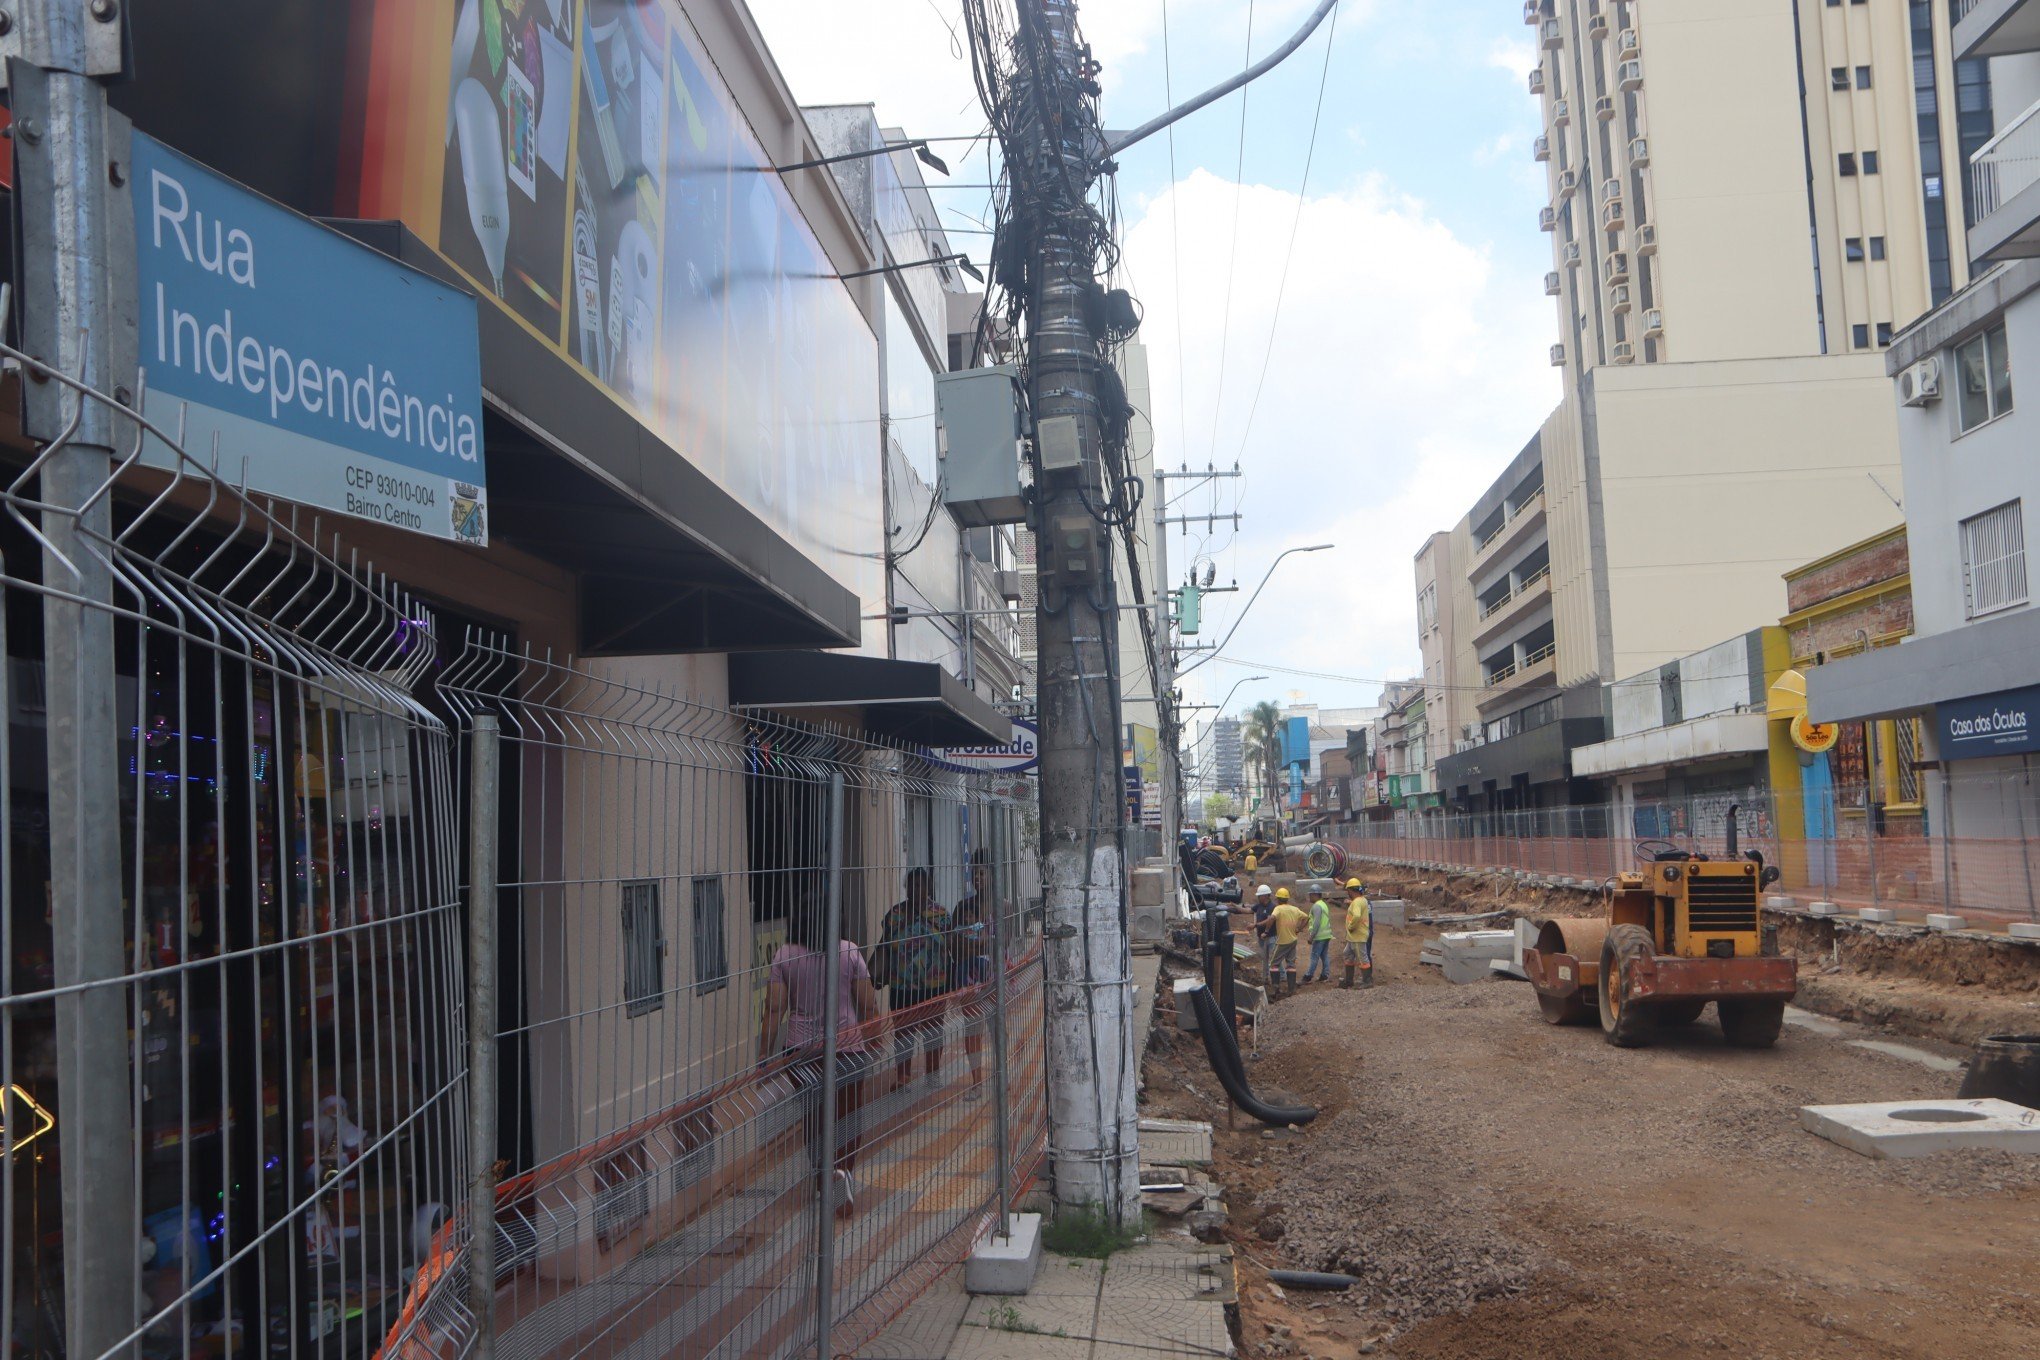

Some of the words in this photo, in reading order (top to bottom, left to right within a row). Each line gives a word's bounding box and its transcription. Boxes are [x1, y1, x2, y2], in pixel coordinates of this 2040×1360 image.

[151, 168, 256, 289] Rua
[482, 215, 499, 229] ELGIN
[155, 281, 478, 464] Independência
[346, 465, 374, 490] CEP
[376, 474, 435, 507] 93010-004
[346, 492, 381, 519] Bairro
[385, 503, 421, 529] Centro
[1950, 718, 1973, 736] Casa
[1974, 715, 1991, 732] dos
[1992, 708, 2027, 730] Óculos
